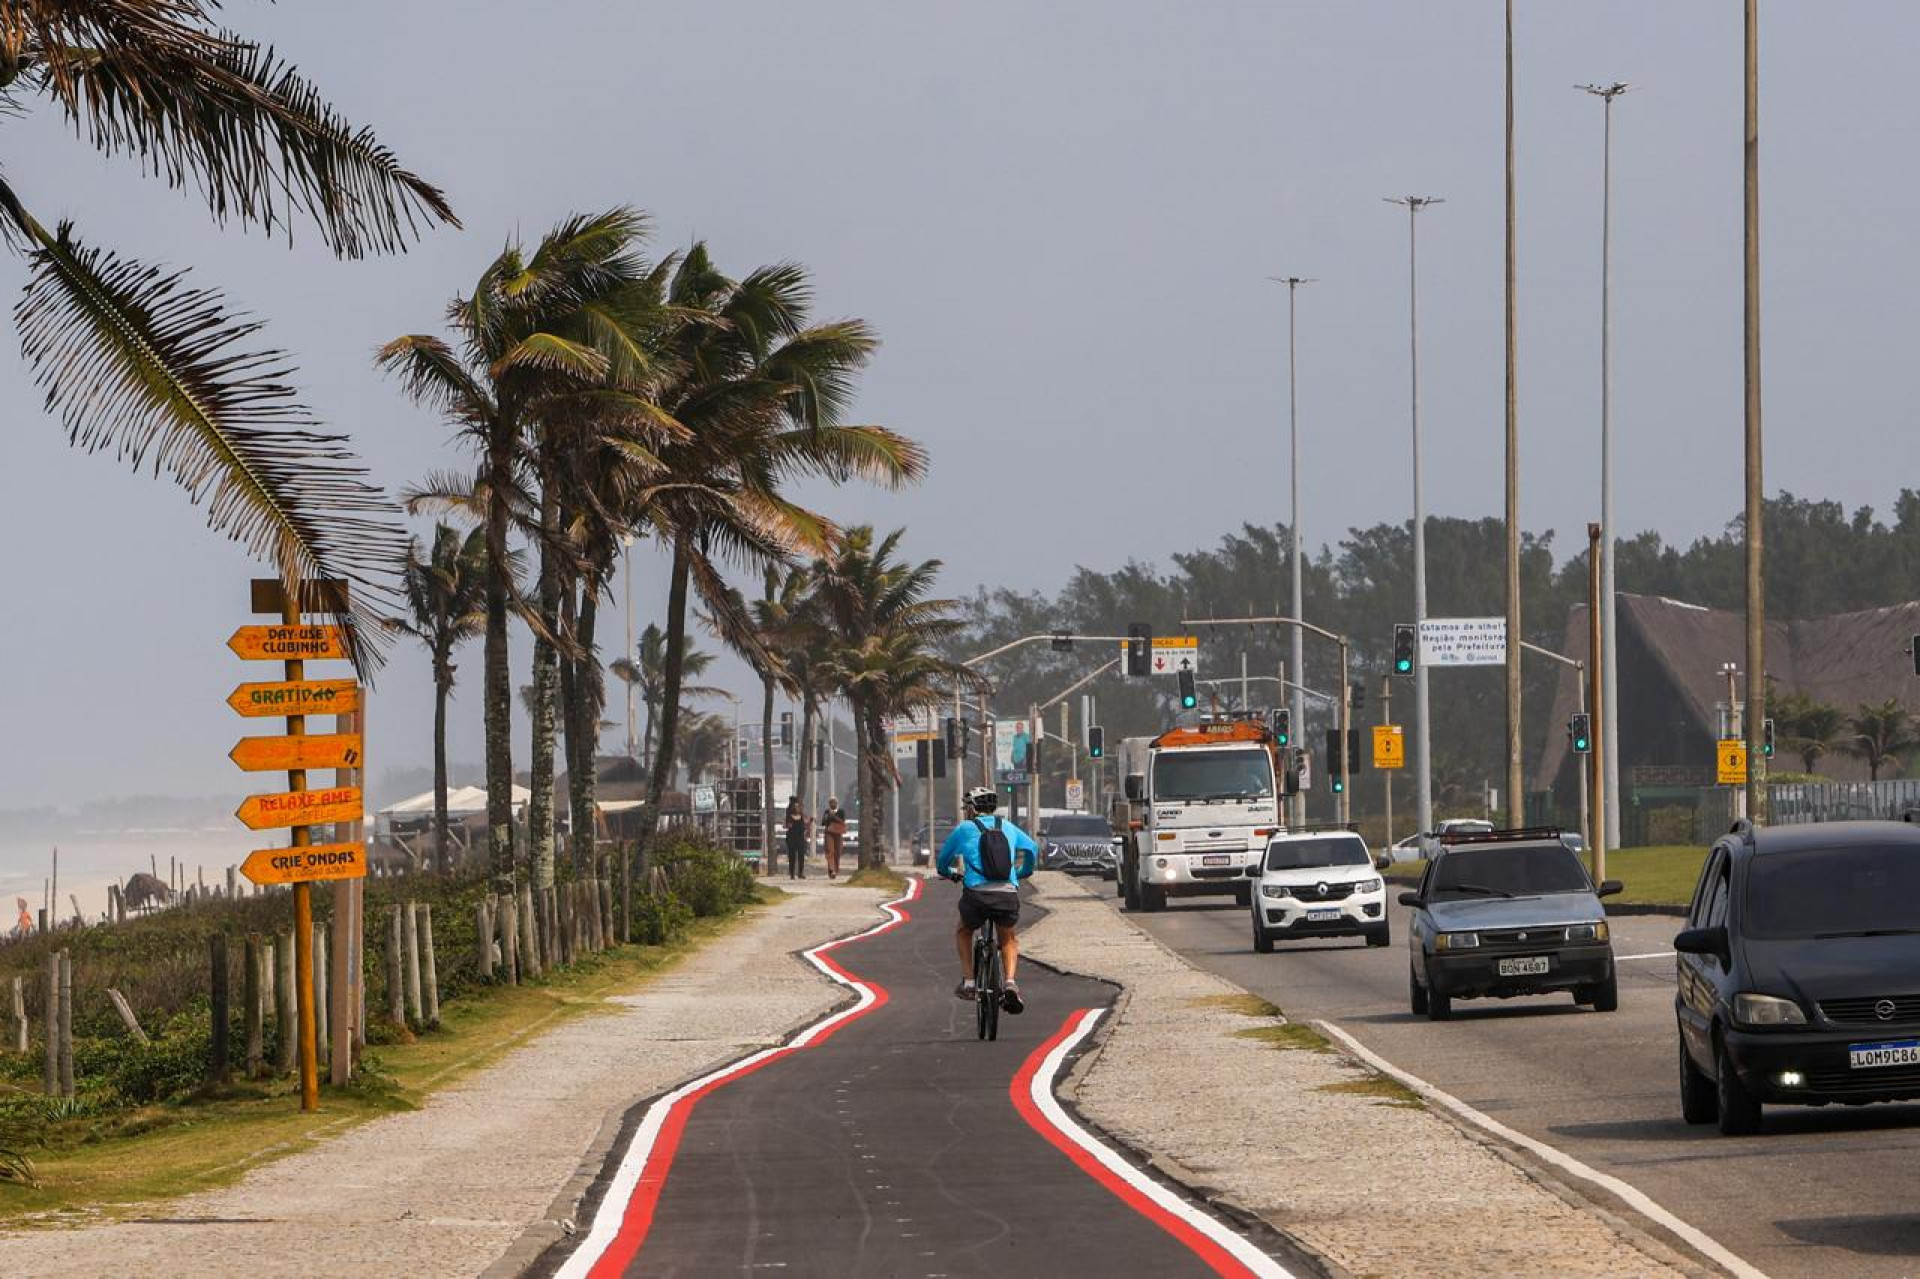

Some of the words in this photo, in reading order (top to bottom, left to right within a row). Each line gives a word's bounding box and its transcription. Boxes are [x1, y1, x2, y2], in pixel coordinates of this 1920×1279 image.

[1420, 623, 1459, 631] Estamos
[1463, 623, 1474, 631] de
[299, 629, 323, 640] USE
[1422, 633, 1455, 644] Região
[262, 642, 329, 653] CLUBINHO
[1431, 644, 1452, 653] pela
[258, 793, 315, 812] RELAXE
[321, 791, 352, 805] AME
[270, 855, 302, 870] CRIE
[306, 851, 355, 867] ONDAS
